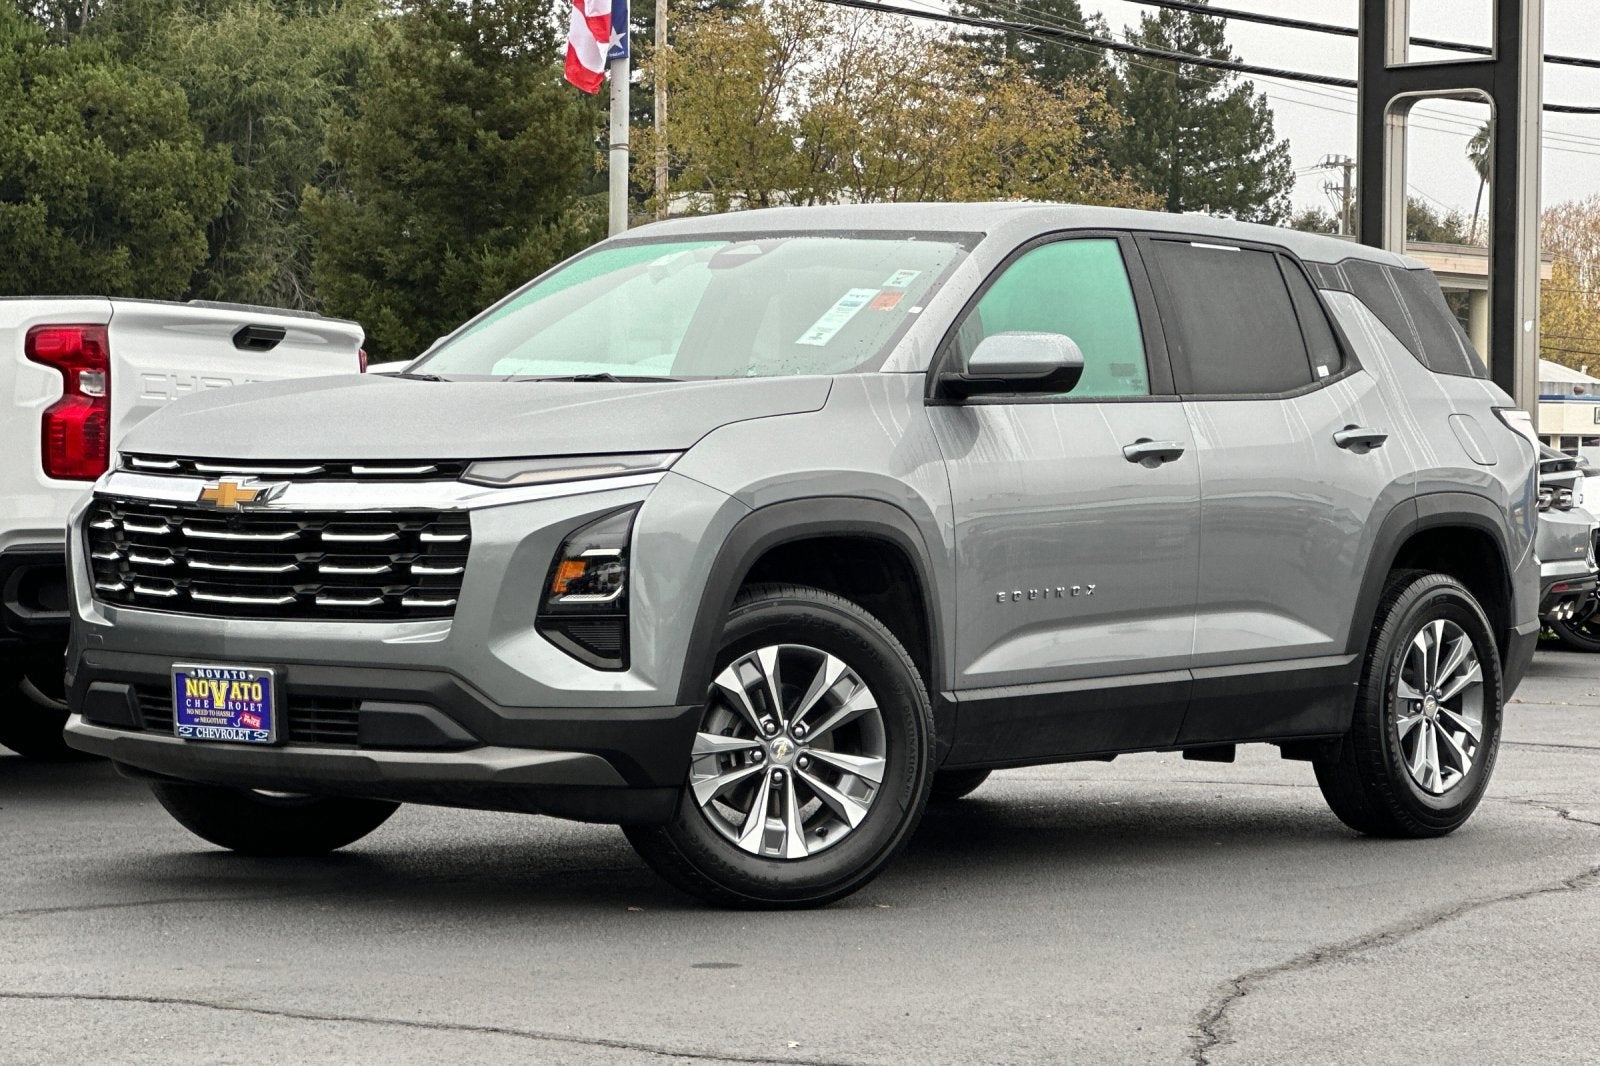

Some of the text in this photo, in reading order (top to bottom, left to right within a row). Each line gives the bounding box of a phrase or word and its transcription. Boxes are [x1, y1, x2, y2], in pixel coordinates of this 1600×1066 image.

[996, 584, 1096, 603] EQUINOX
[197, 669, 246, 680] NOVATO
[185, 678, 262, 710] NOVATO
[196, 727, 251, 741] CHEVROLET
